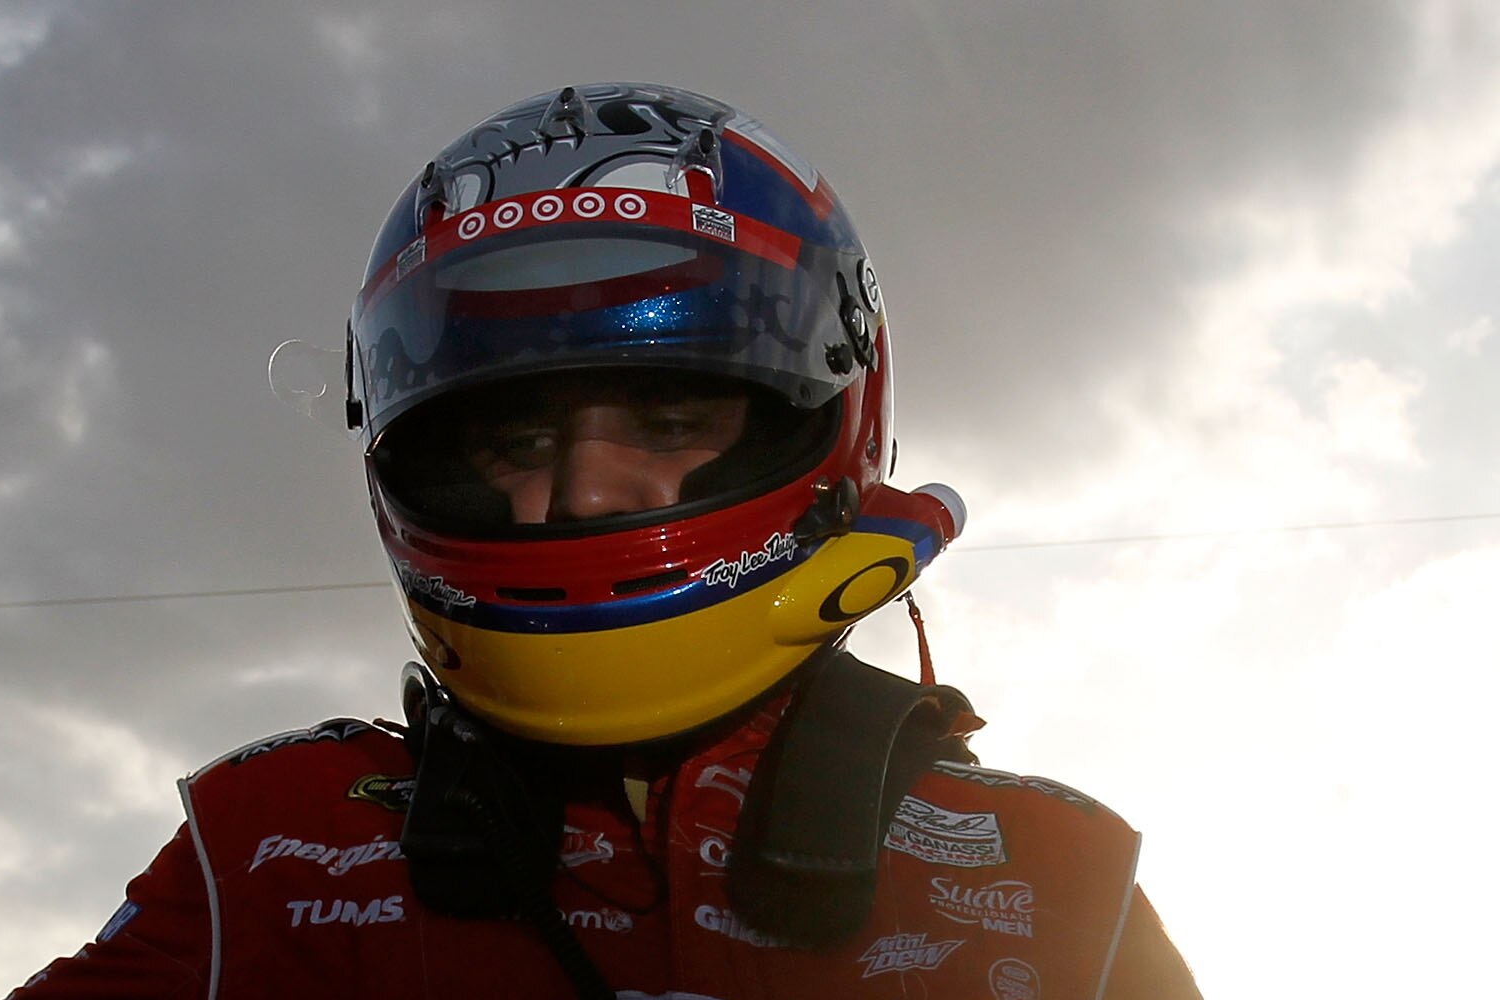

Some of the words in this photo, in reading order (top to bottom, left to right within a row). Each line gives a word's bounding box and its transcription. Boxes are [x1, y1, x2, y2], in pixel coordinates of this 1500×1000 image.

[702, 558, 740, 588] Troy
[740, 551, 769, 575] Lee
[764, 532, 798, 560] Desig
[248, 834, 406, 877] Energiz
[286, 895, 404, 928] TUMS
[928, 877, 1036, 913] Suave
[981, 917, 1034, 938] MEN
